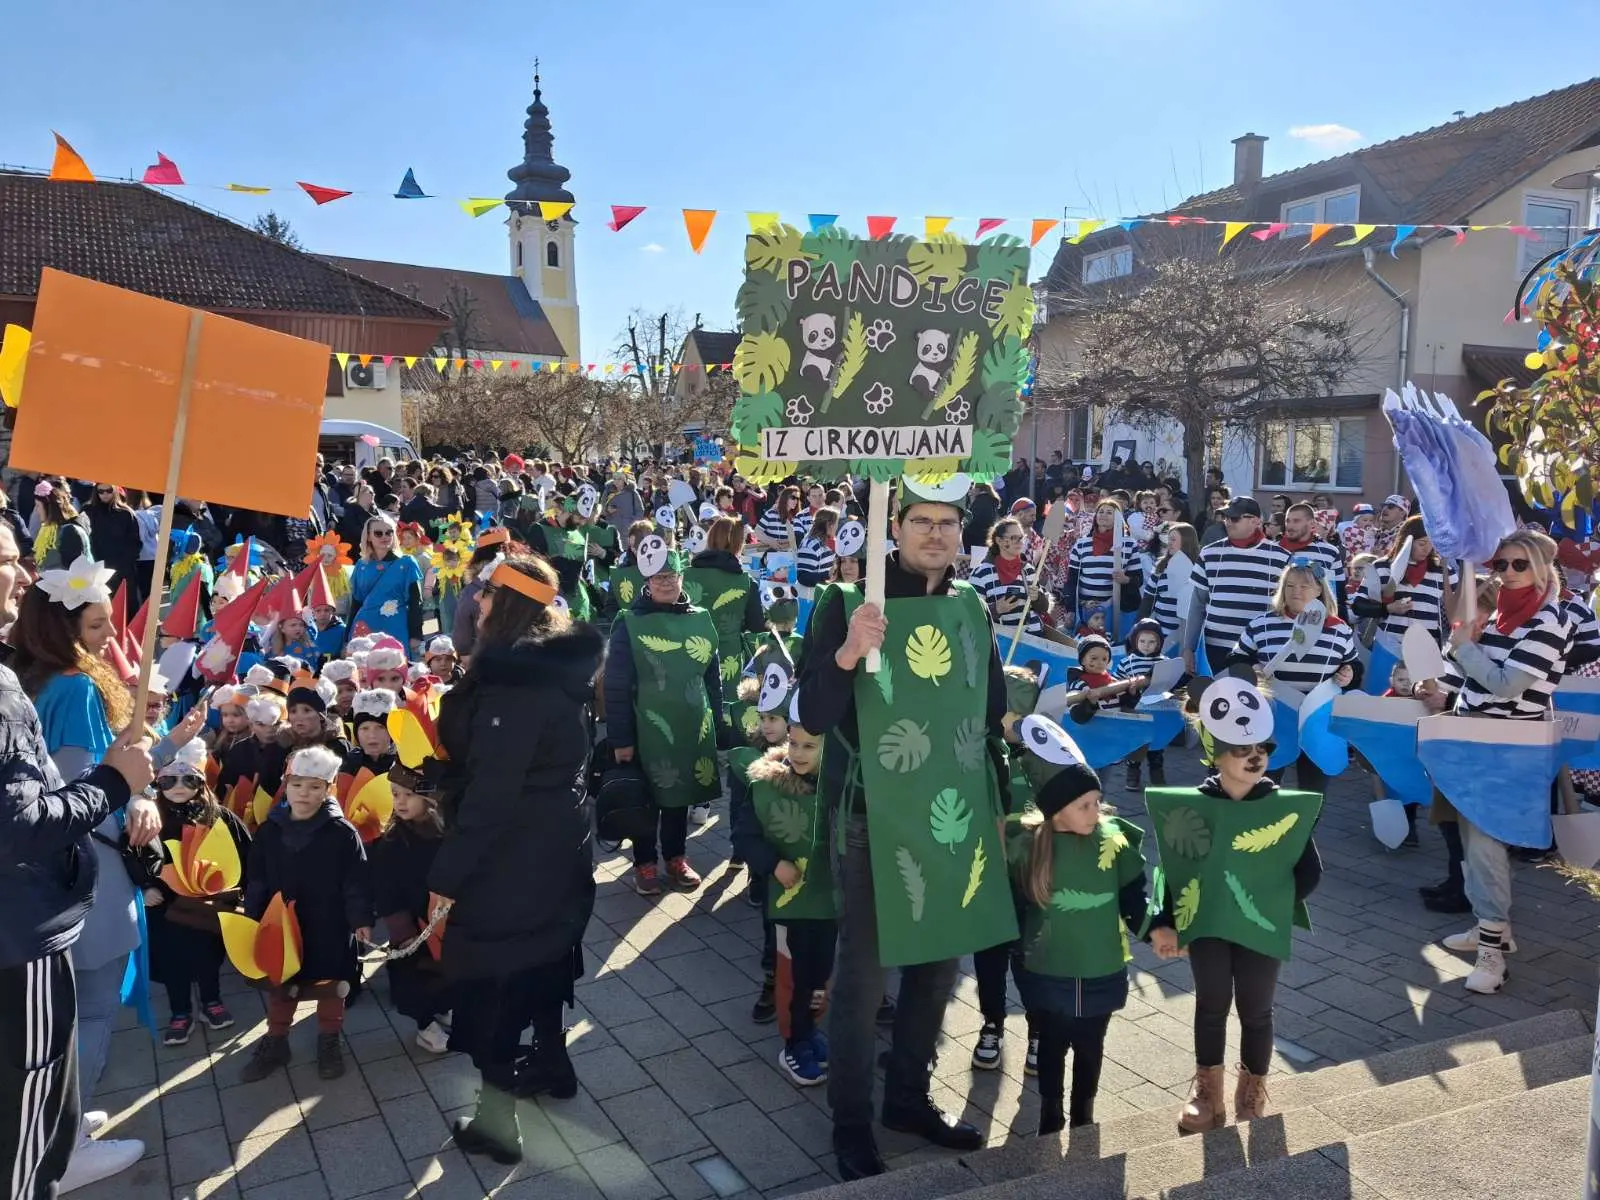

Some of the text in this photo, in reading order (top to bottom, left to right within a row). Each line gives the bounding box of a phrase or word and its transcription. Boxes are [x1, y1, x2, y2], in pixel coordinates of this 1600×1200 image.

[786, 259, 1010, 320] PANDICE
[766, 427, 965, 457] IZ CIRKOVLJANA
